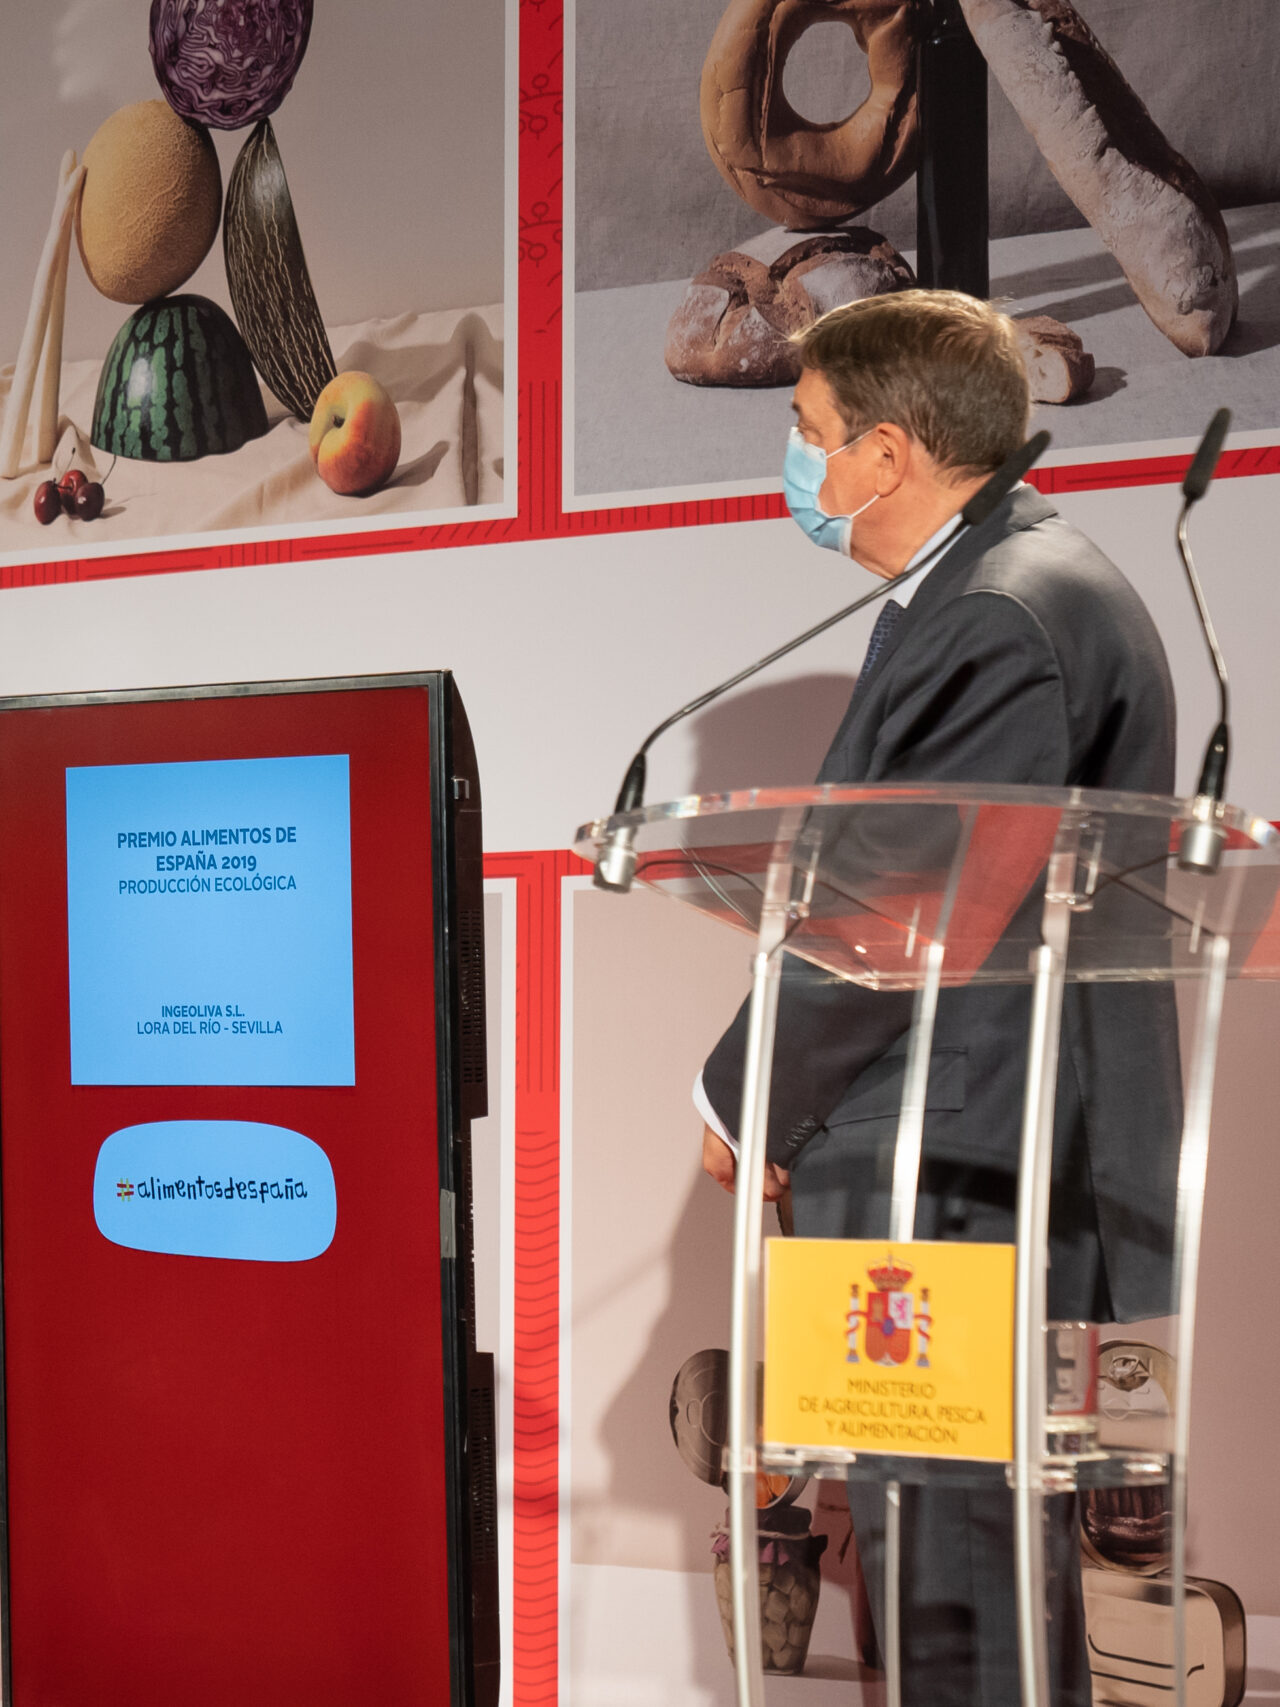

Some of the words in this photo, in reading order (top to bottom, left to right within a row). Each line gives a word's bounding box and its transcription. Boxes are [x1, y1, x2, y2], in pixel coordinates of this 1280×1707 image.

[117, 831, 177, 848] PREMIO
[180, 828, 271, 846] ALIMENTOS
[275, 826, 296, 843] DE
[156, 851, 217, 872] ESPAÑA
[221, 855, 257, 871] 2019
[119, 875, 210, 894] PRODUCCIÓN
[214, 873, 297, 892] ECOLÓGICA
[161, 1005, 222, 1018] INGEOLIVA
[225, 1005, 245, 1017] S.L.
[137, 1021, 170, 1035] LORA
[173, 1021, 196, 1034] DEL
[200, 1019, 220, 1034] RÍO
[232, 1021, 283, 1034] SEVILLA
[847, 1379, 935, 1400] MINISTERIO
[798, 1397, 818, 1412] DE
[937, 1406, 987, 1424] PESCA
[824, 1420, 836, 1434] Y
